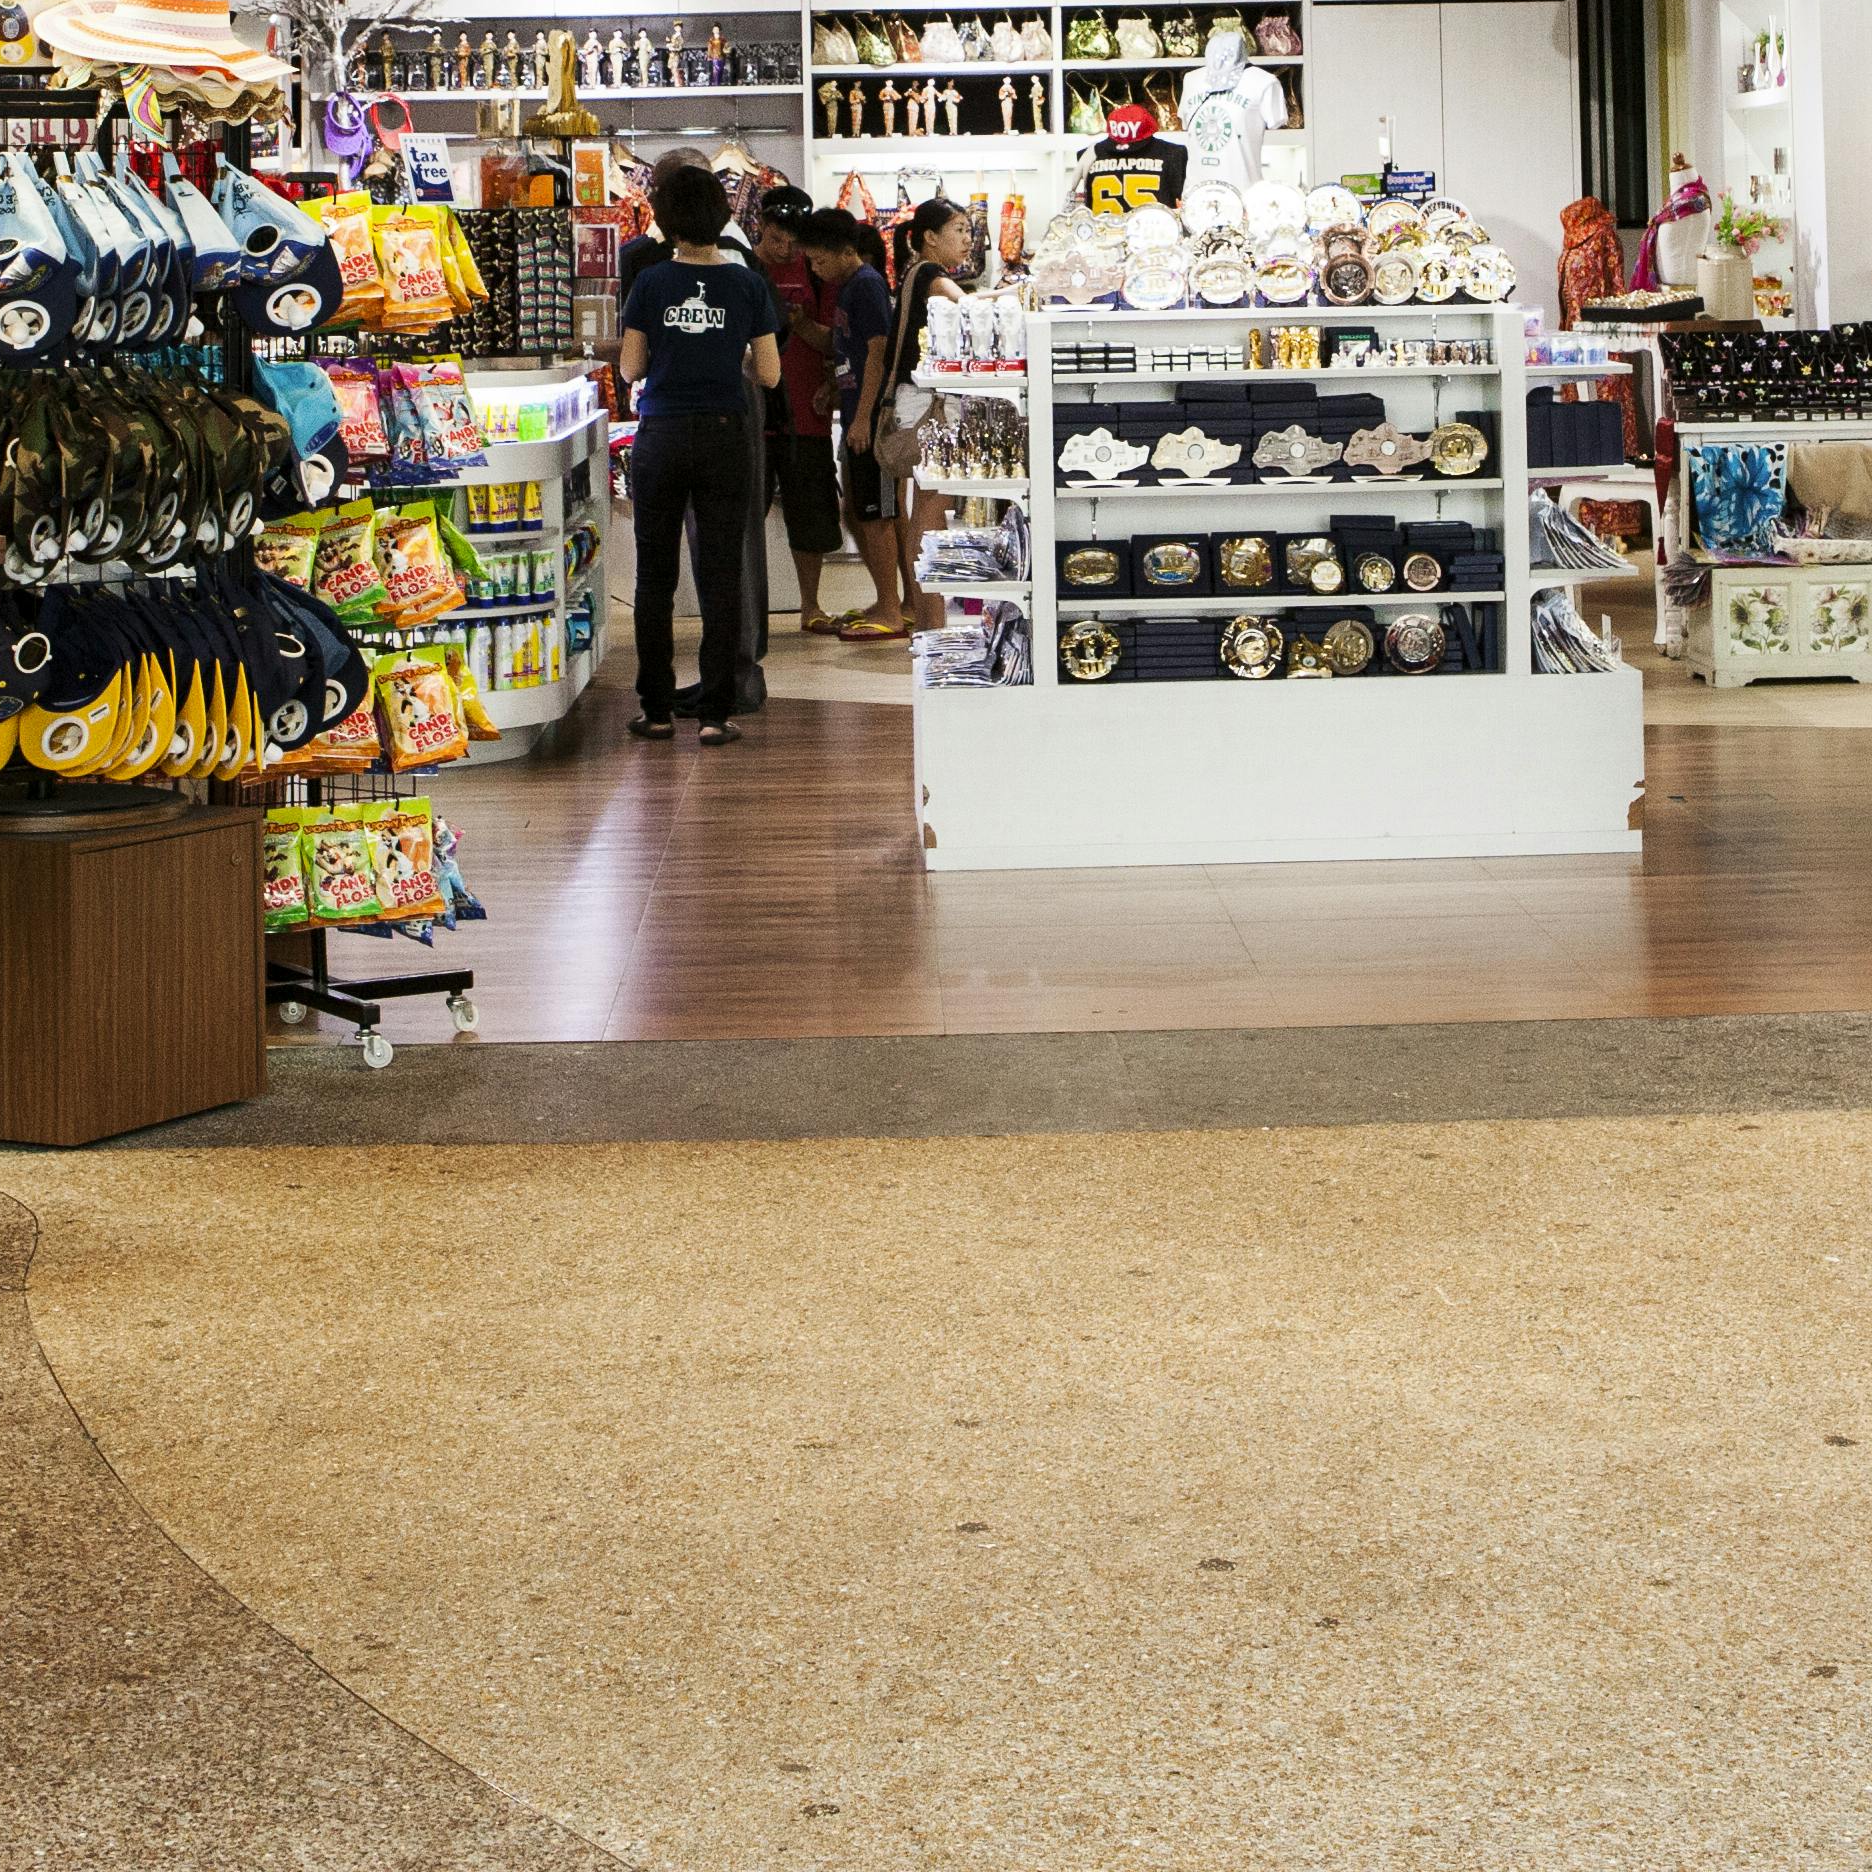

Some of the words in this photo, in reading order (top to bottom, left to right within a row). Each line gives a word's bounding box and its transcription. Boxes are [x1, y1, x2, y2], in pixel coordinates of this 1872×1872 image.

[1110, 121, 1141, 138] BOY
[410, 147, 438, 162] tax
[416, 164, 447, 184] free
[1092, 174, 1161, 216] 65
[665, 308, 725, 327] CREW
[408, 713, 451, 739] CAND
[330, 873, 367, 897] CAND
[391, 871, 433, 896] CAND
